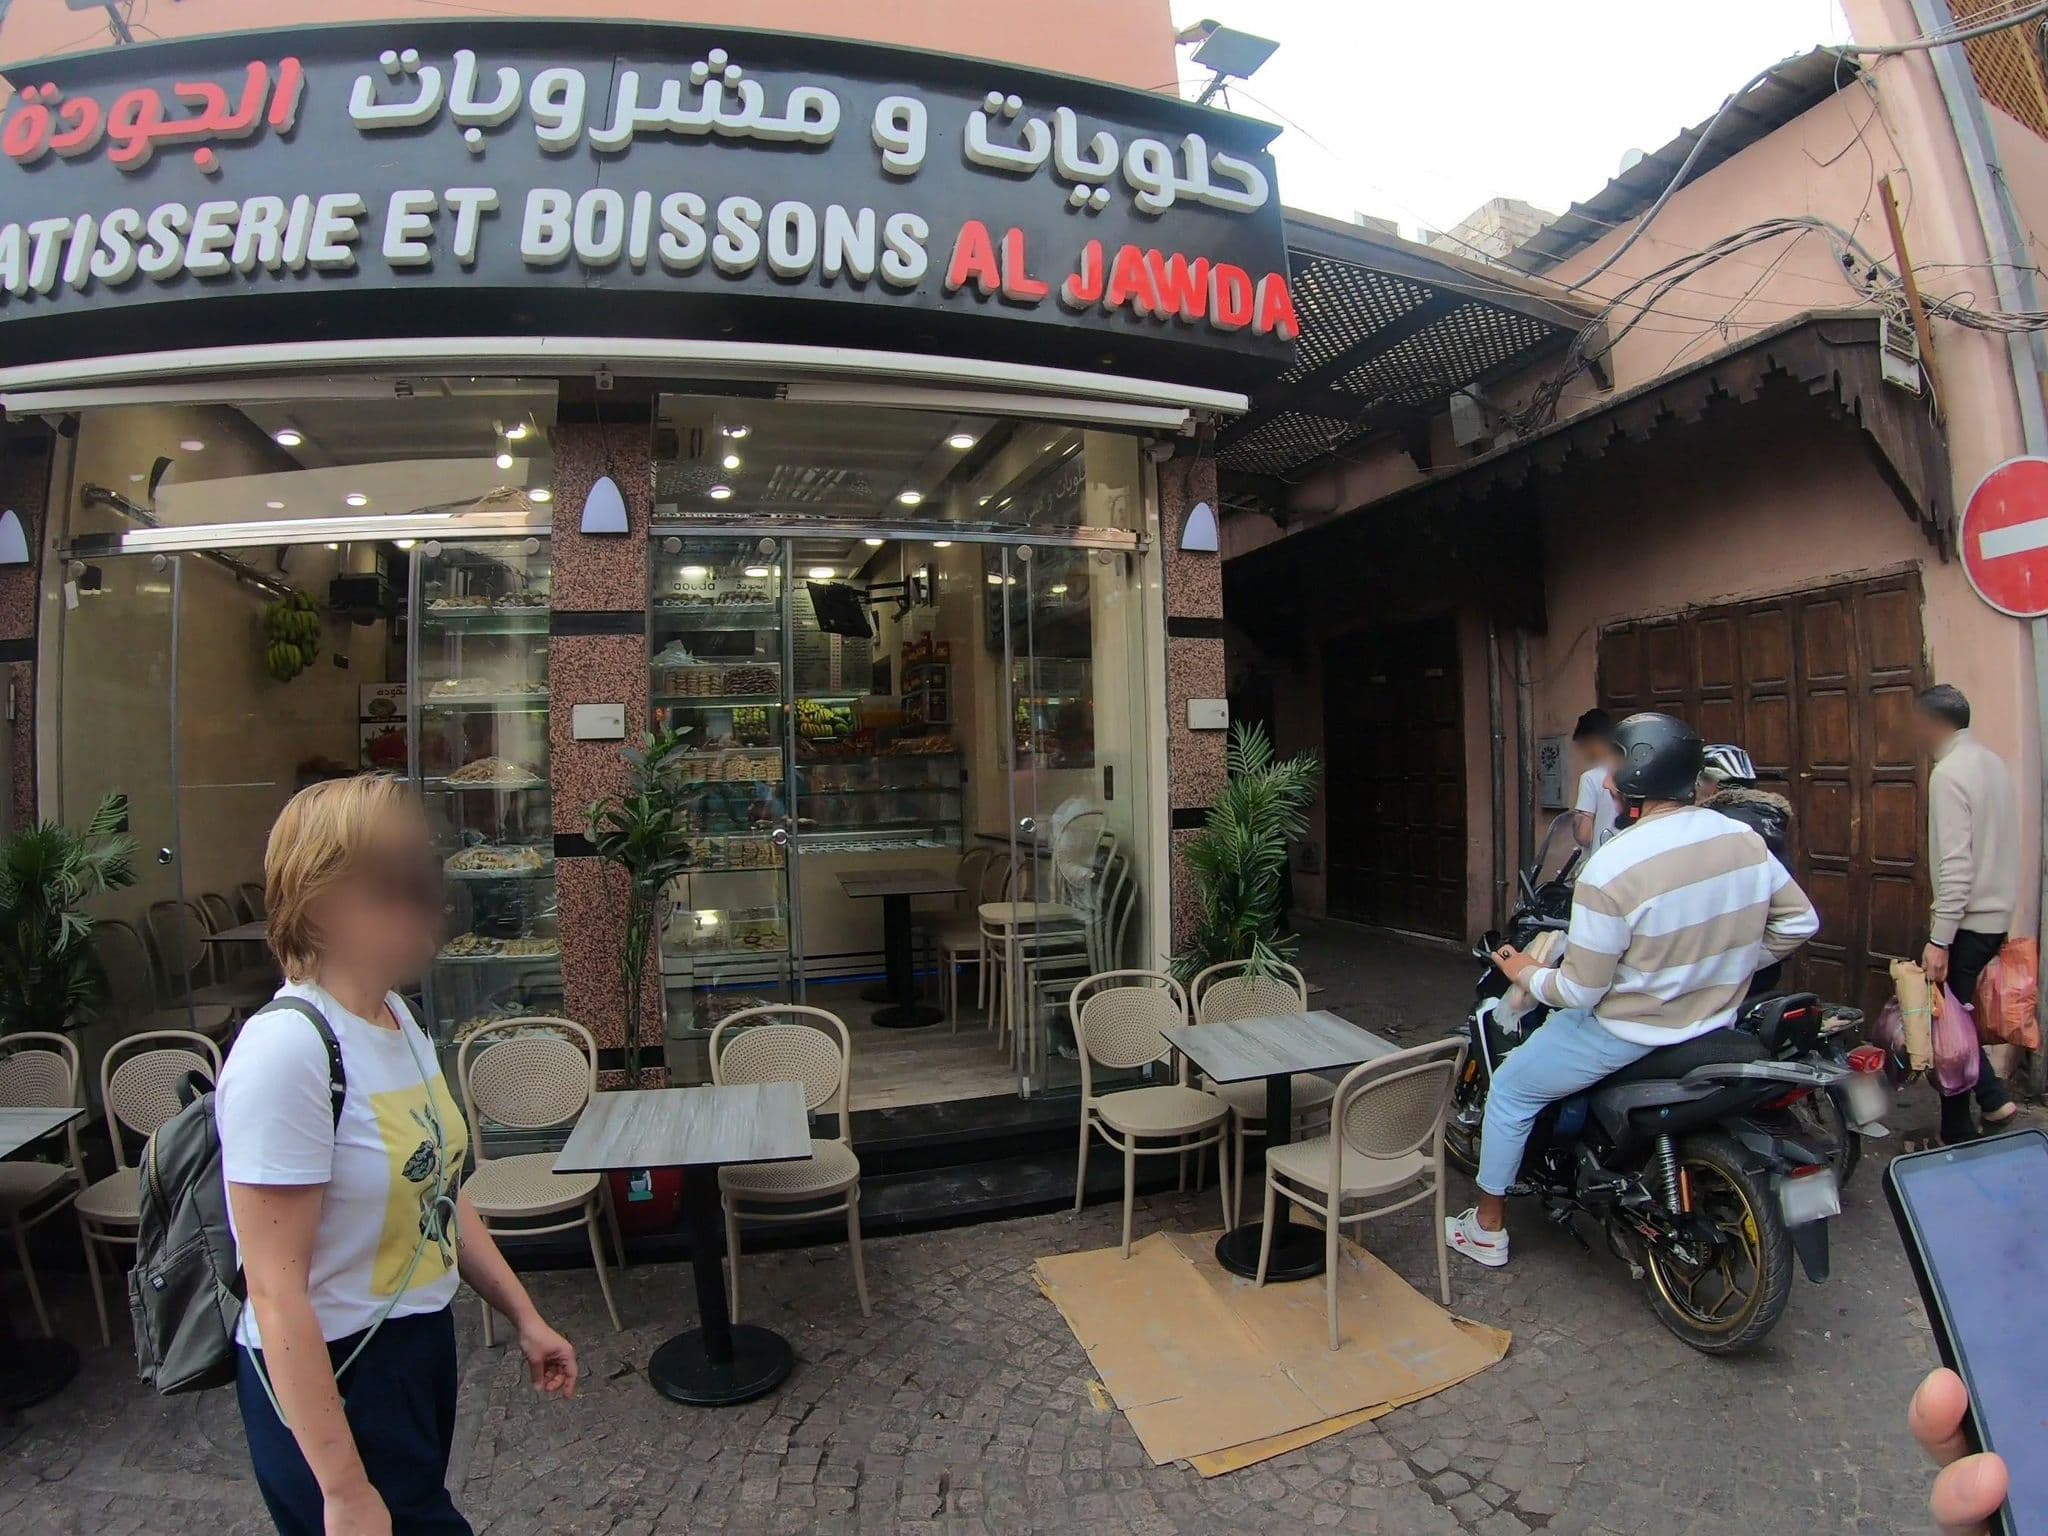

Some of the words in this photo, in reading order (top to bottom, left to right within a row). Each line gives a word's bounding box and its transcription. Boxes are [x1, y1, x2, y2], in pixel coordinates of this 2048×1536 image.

[2, 56, 304, 175] الجودة
[348, 48, 841, 154] مشروبات
[873, 96, 928, 176] و
[964, 91, 1269, 214] حلويات
[382, 187, 499, 265] ET
[519, 187, 929, 287] BOISSONS
[944, 220, 1048, 301] AL
[1060, 239, 1300, 341] JAWDA
